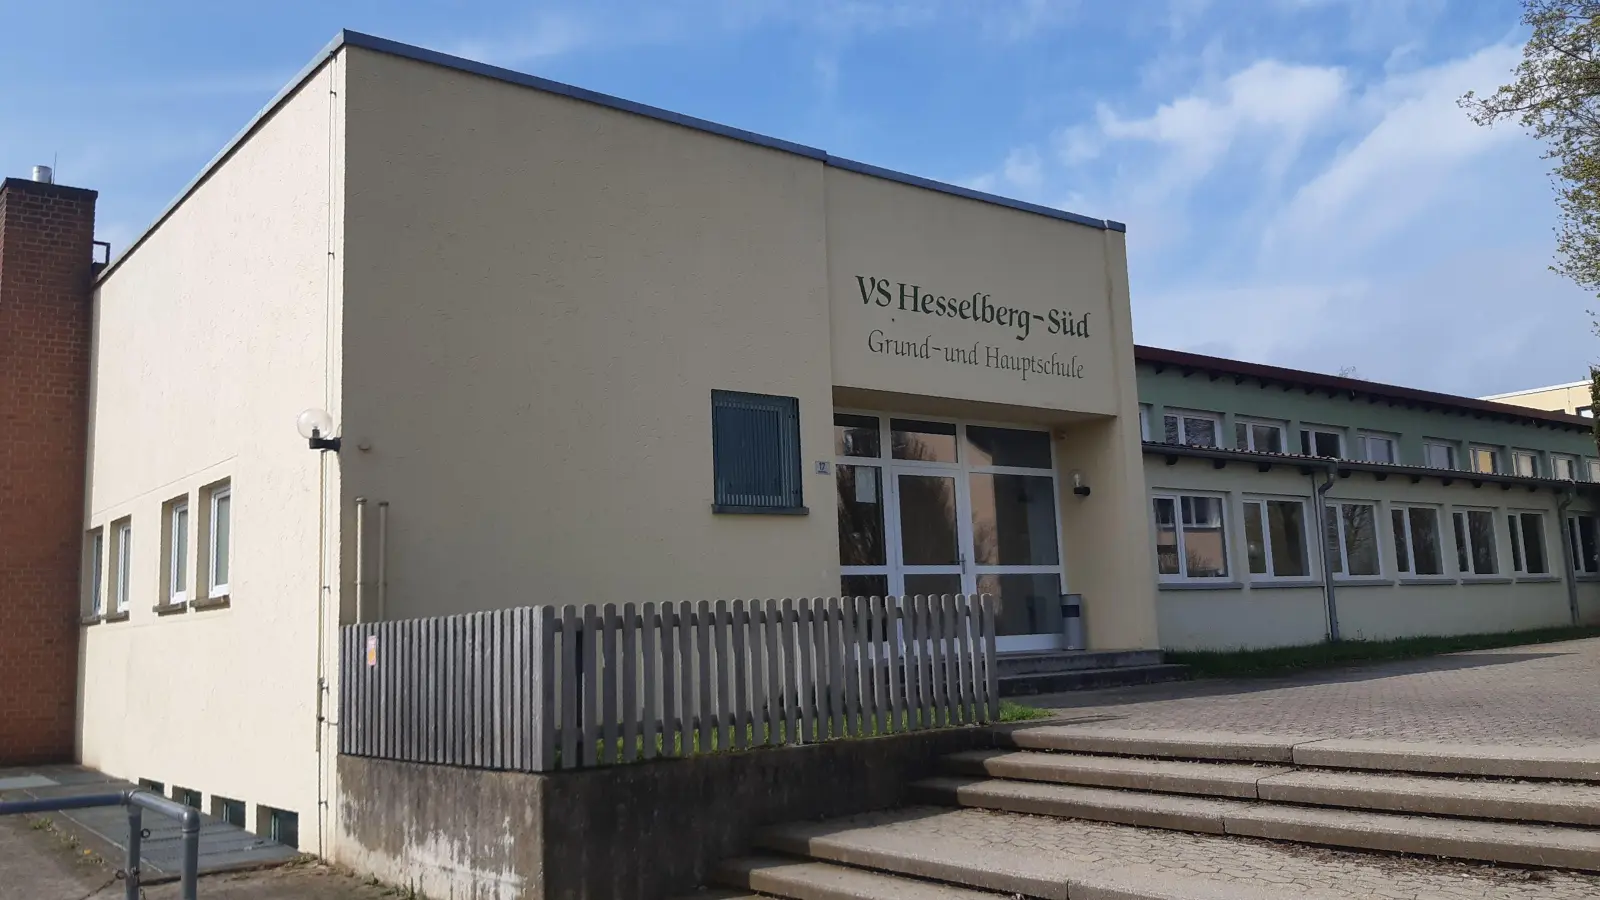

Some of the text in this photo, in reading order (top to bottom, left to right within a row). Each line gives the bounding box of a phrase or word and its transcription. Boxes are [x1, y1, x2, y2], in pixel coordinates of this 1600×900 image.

[855, 275, 1091, 341] VS Hesselberg-Süd
[984, 345, 1084, 381] Hauptschule
